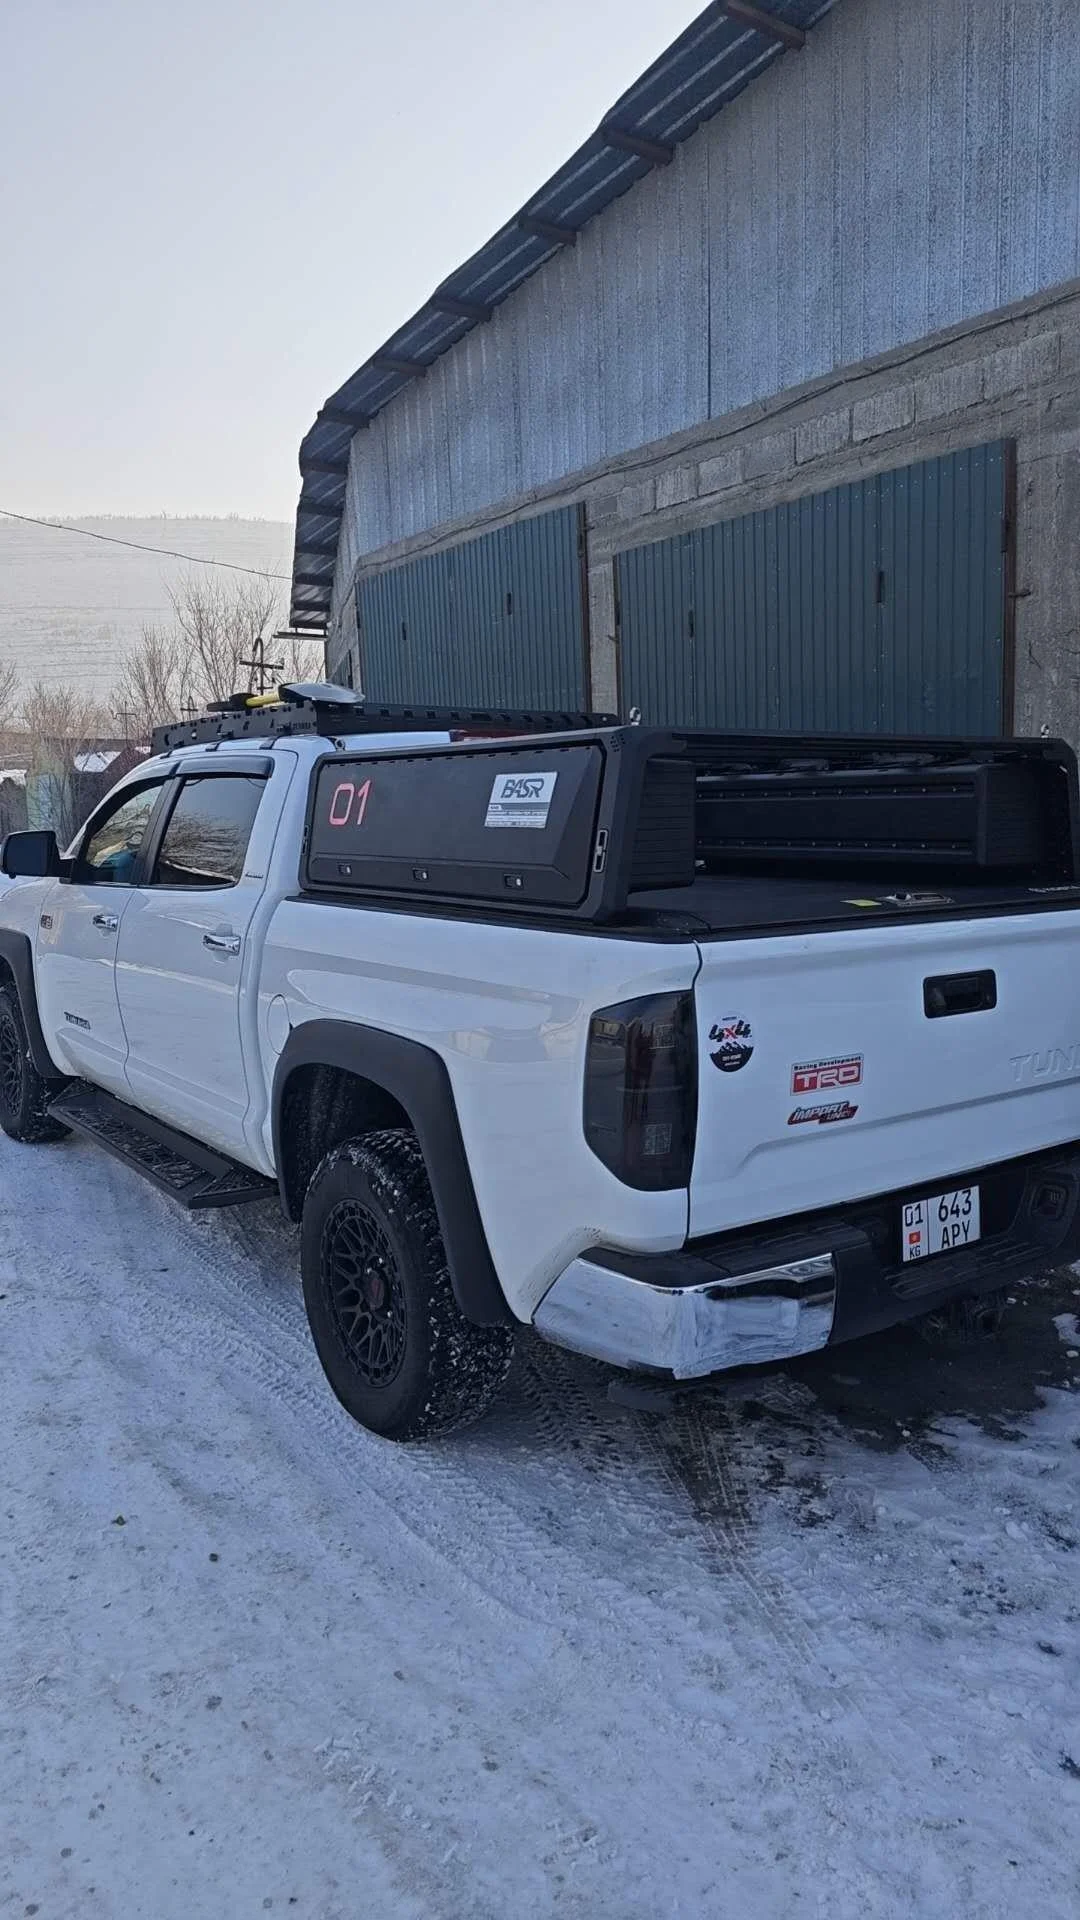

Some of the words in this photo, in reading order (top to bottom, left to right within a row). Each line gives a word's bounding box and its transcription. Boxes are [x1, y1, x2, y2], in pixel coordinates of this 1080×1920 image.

[330, 780, 371, 825] 01
[794, 1063, 818, 1071] Racing
[819, 1056, 861, 1067] Development
[795, 1065, 860, 1090] TRD
[905, 1203, 923, 1227] 01
[938, 1189, 972, 1222] 643
[941, 1220, 970, 1248] APY
[909, 1246, 921, 1258] KG
